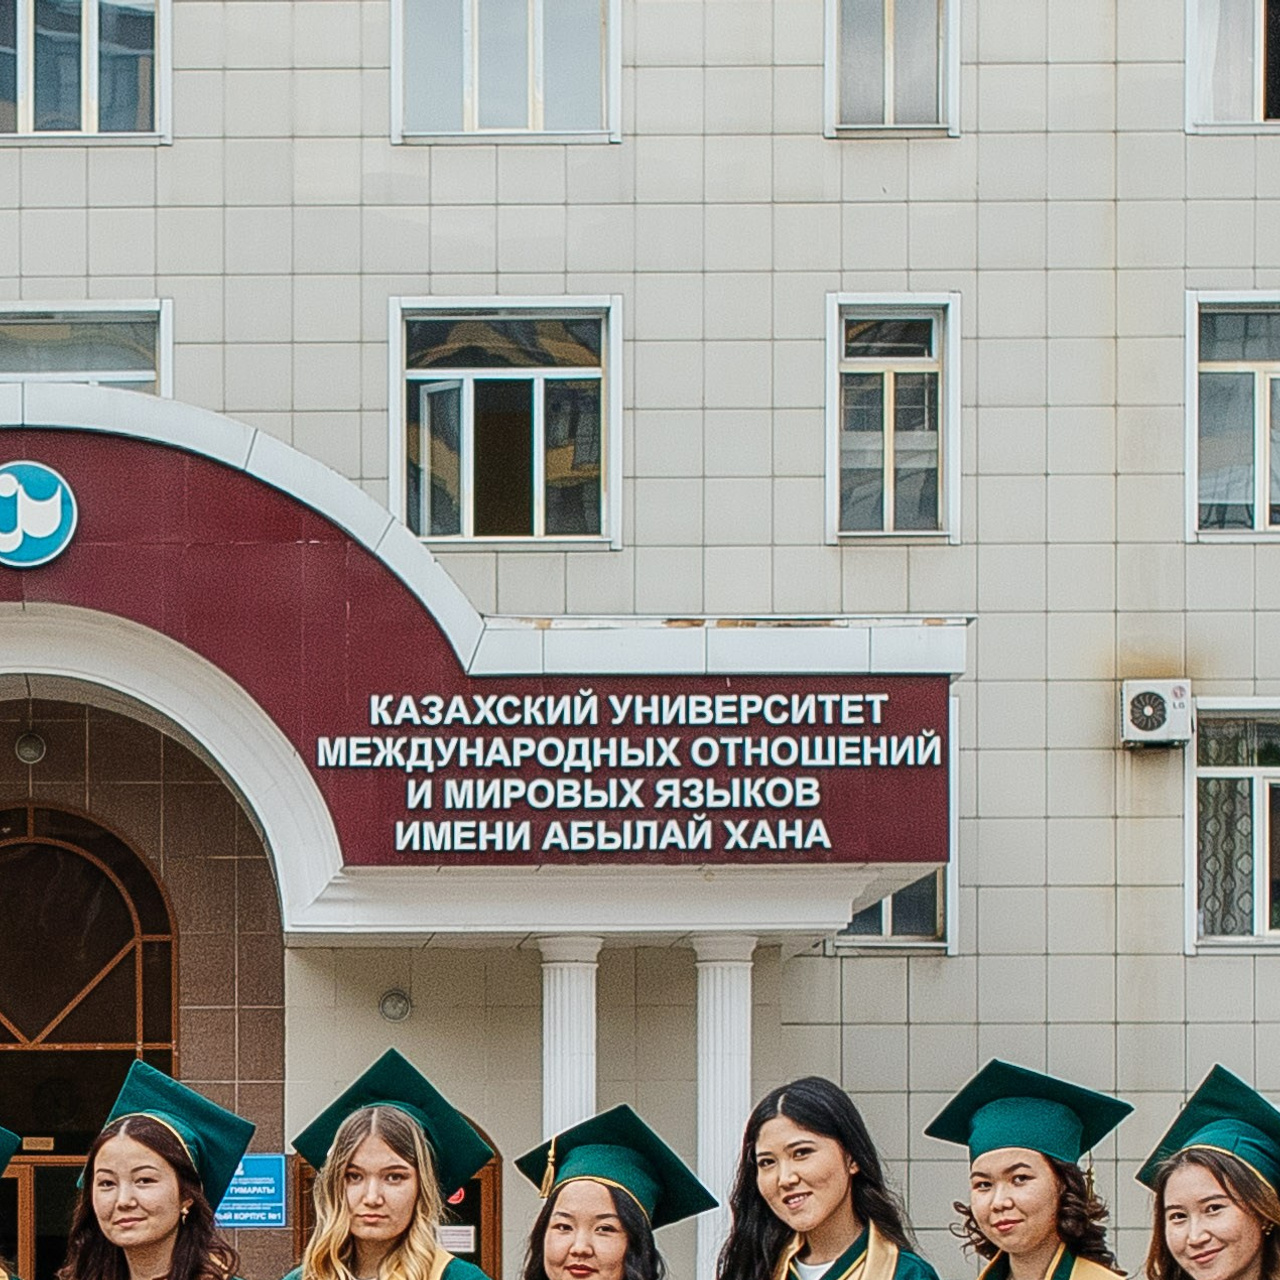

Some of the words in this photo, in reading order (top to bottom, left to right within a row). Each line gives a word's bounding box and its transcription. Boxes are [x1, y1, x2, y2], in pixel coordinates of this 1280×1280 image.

[371, 687, 597, 724] КАЗАХСКИЙ
[609, 694, 888, 724] УНИВЕРСИТЕТ
[1172, 701, 1186, 710] LG
[318, 737, 681, 772] МЕЖДУНАРОДНЫХ
[691, 729, 941, 766] ОТНОШЕНИЙ
[407, 779, 432, 808] И
[444, 779, 644, 808] МИРОВЫХ
[654, 777, 821, 808] ЯЗЫКОВ
[396, 821, 531, 850] ИМЕНИ
[542, 813, 712, 850] АБЫЛАЙ
[724, 819, 832, 849] ХАНА
